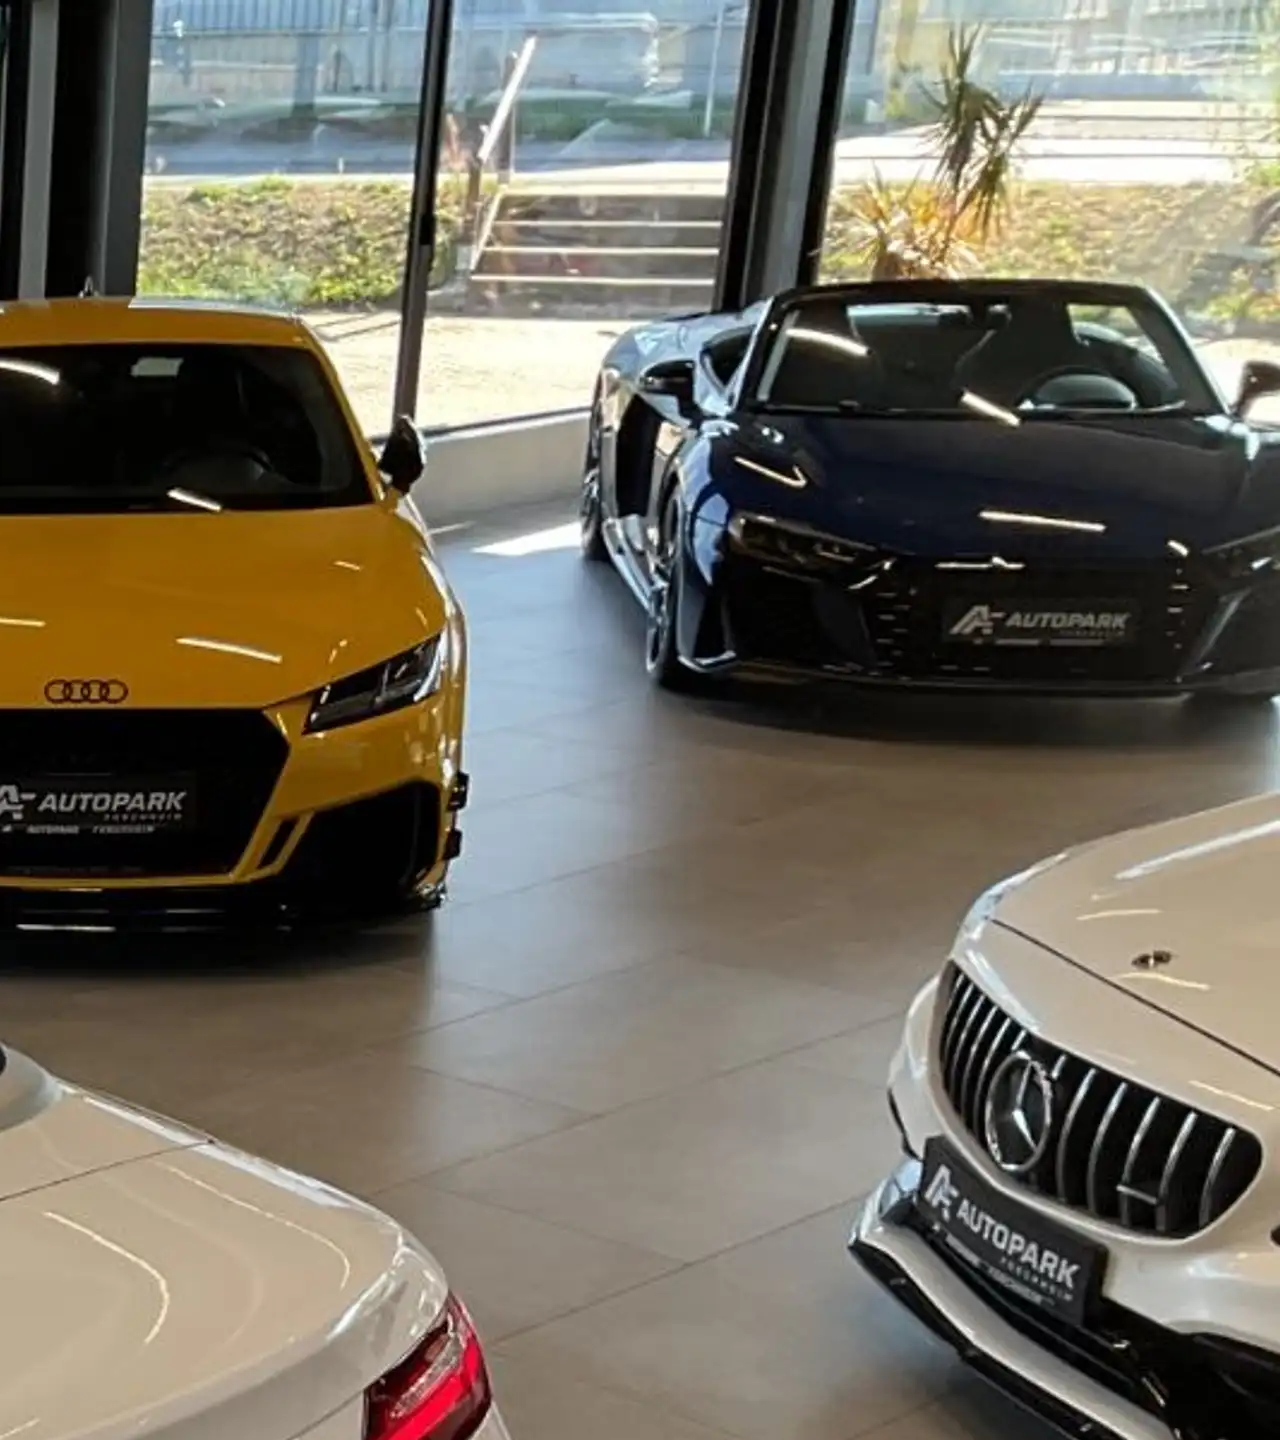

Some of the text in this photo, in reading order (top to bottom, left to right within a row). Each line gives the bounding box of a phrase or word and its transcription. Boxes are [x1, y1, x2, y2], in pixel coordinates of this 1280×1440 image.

[1007, 612, 1130, 628] AUTOPARK
[38, 791, 186, 813] AUTOPARK
[955, 1197, 1082, 1290] AUTOPARK
